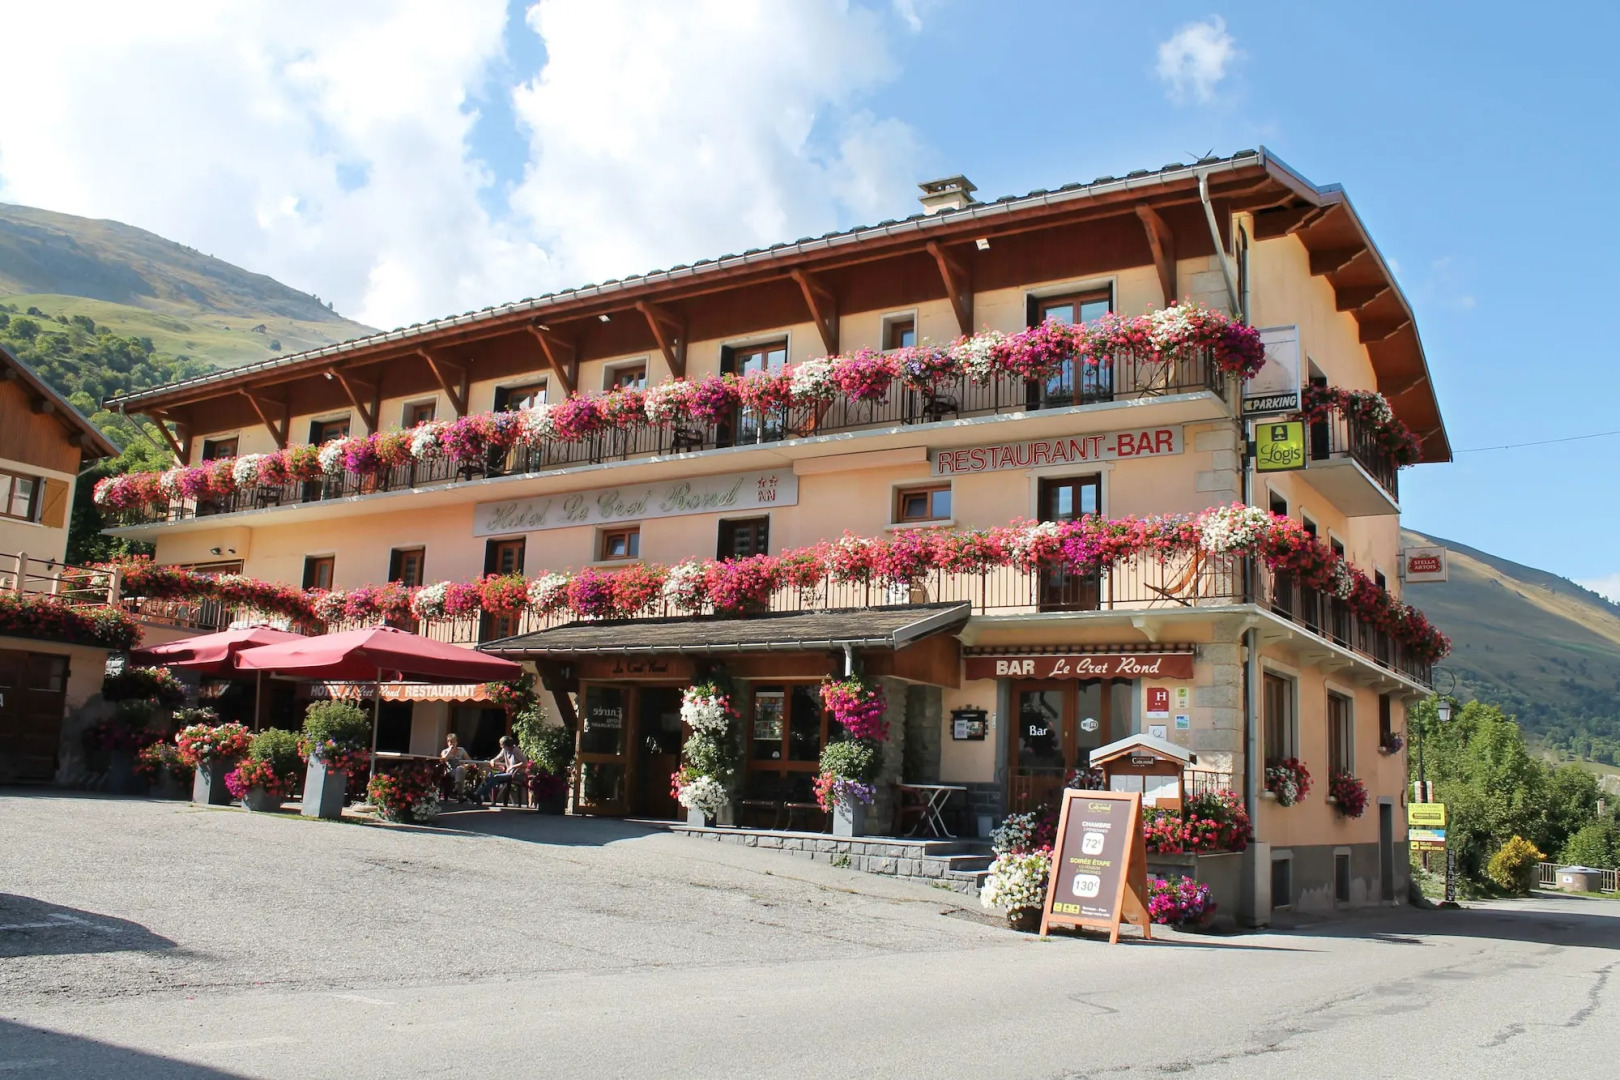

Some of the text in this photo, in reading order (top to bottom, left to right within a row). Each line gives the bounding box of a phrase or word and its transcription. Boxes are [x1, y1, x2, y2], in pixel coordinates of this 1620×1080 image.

[1252, 395, 1297, 410] PARKING
[1259, 442, 1301, 465] Logis
[558, 493, 589, 522] Le
[659, 477, 744, 512] Rond
[996, 657, 1163, 677] BAR Le Cret Rond
[379, 684, 402, 698] Rond
[404, 684, 477, 698] RESTAURANT
[1156, 691, 1167, 701] H
[1029, 725, 1048, 736] Bar
